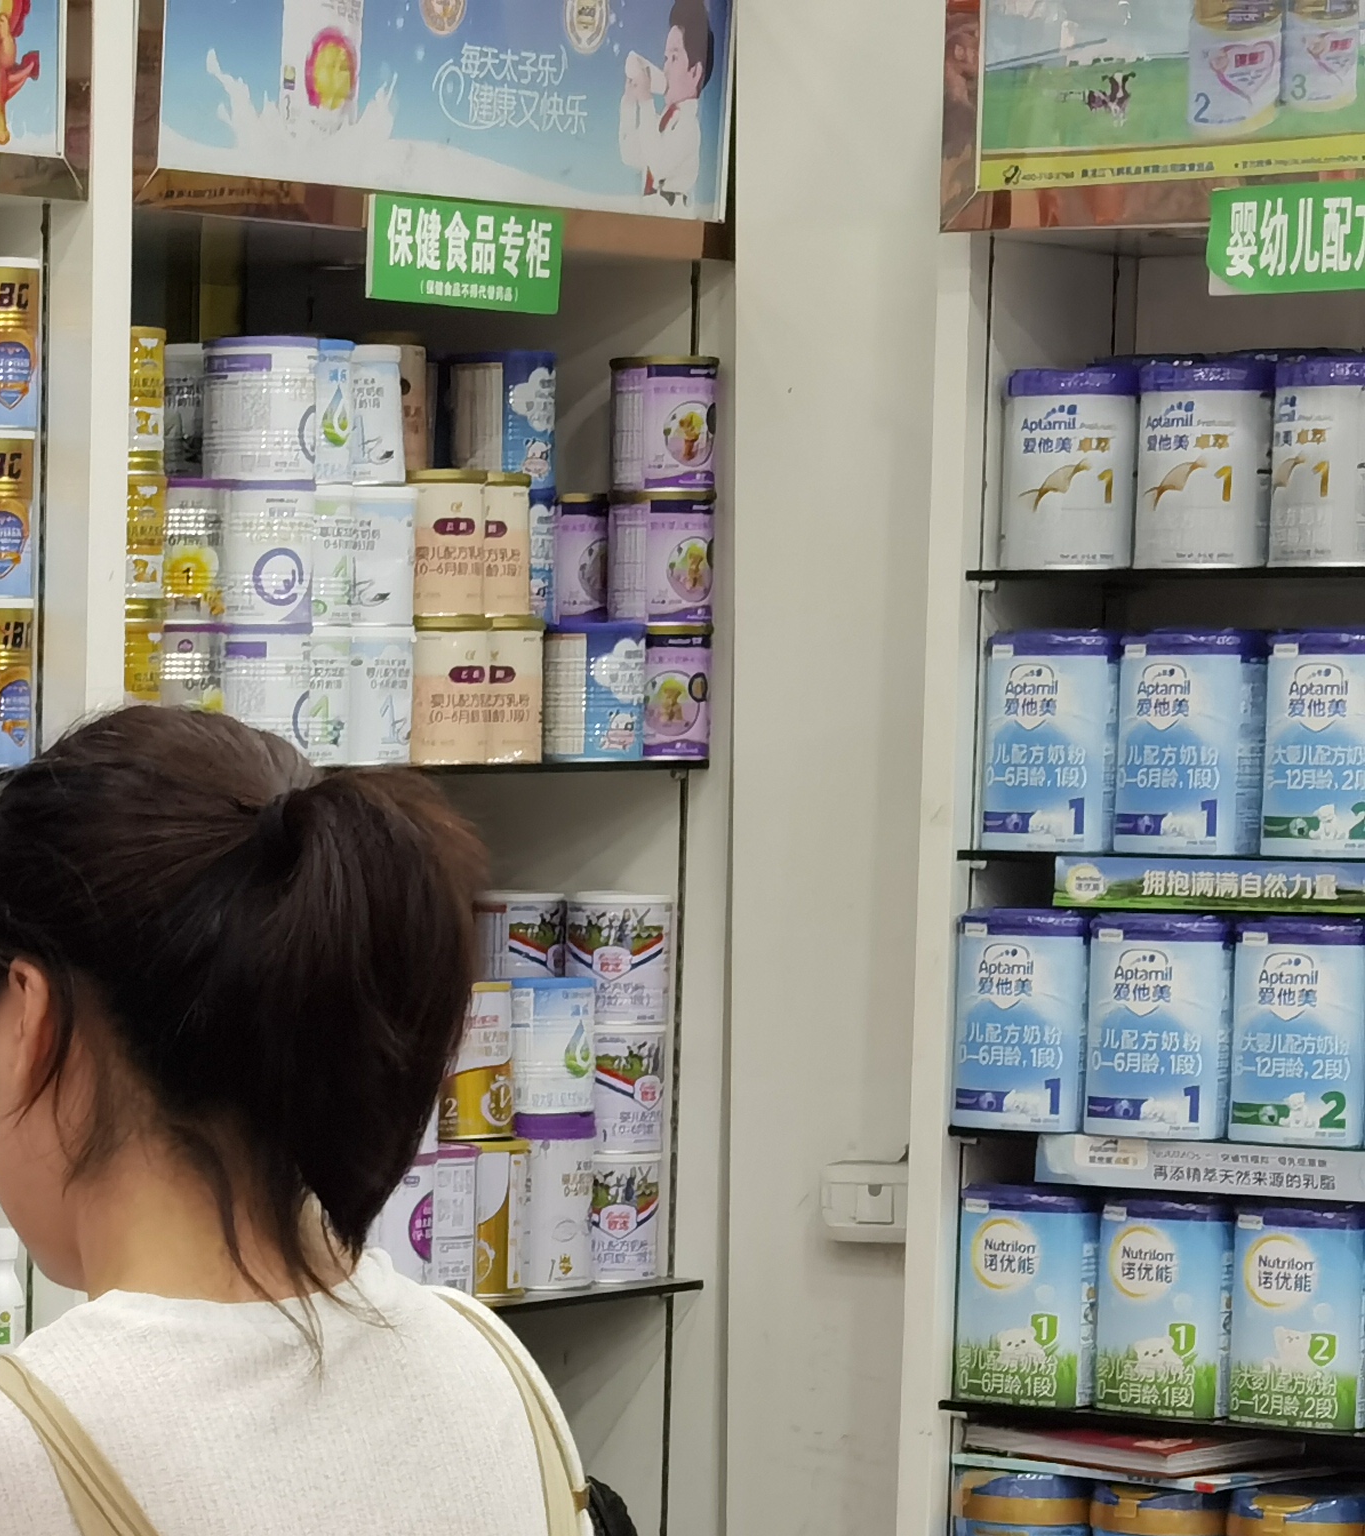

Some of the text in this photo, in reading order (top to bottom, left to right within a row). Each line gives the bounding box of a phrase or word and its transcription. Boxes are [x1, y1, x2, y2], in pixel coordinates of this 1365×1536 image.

[468, 84, 588, 136] 健康又快乐
[1194, 93, 1212, 123] 2
[387, 203, 551, 279] 保健食品专柜
[1021, 417, 1076, 432] Aptamil
[1145, 413, 1194, 429] Aptamil
[1022, 436, 1072, 454] 爱他美
[1146, 434, 1190, 451] 爱他美
[1097, 469, 1113, 504] 1
[1214, 466, 1233, 502] 1
[1312, 461, 1329, 497] 1
[1005, 680, 1058, 698] Aptamil
[1137, 680, 1190, 698] Aptamil
[1288, 680, 1348, 699] Aptamil
[1005, 699, 1057, 717] 爱他美
[1137, 699, 1190, 717] 爱他美
[1288, 700, 1347, 718] 爱他美
[1068, 798, 1084, 835] 1
[1200, 799, 1217, 837] 1
[1141, 869, 1339, 900] 拥抱满满自然力量
[978, 958, 1034, 977] Aptamil
[1114, 966, 1173, 982] Aptamil
[978, 977, 1033, 996] 爱他美
[1259, 970, 1318, 986] Aptamil
[1113, 983, 1172, 1002] 爱他美
[1258, 987, 1317, 1007] 爱他美
[1044, 1079, 1059, 1115] 1
[1183, 1085, 1200, 1123] 1
[1319, 1090, 1346, 1128] 2
[983, 1238, 1036, 1255] Nutrilon
[1121, 1246, 1175, 1263] Nutrilon
[983, 1254, 1035, 1276] 诺优能
[1121, 1261, 1173, 1285] 诺优能
[1258, 1256, 1314, 1271] Nutrilon
[1258, 1270, 1313, 1293] 诺优能
[1036, 1315, 1052, 1341] 1
[1175, 1325, 1190, 1351] 1
[1313, 1335, 1331, 1362] 2
